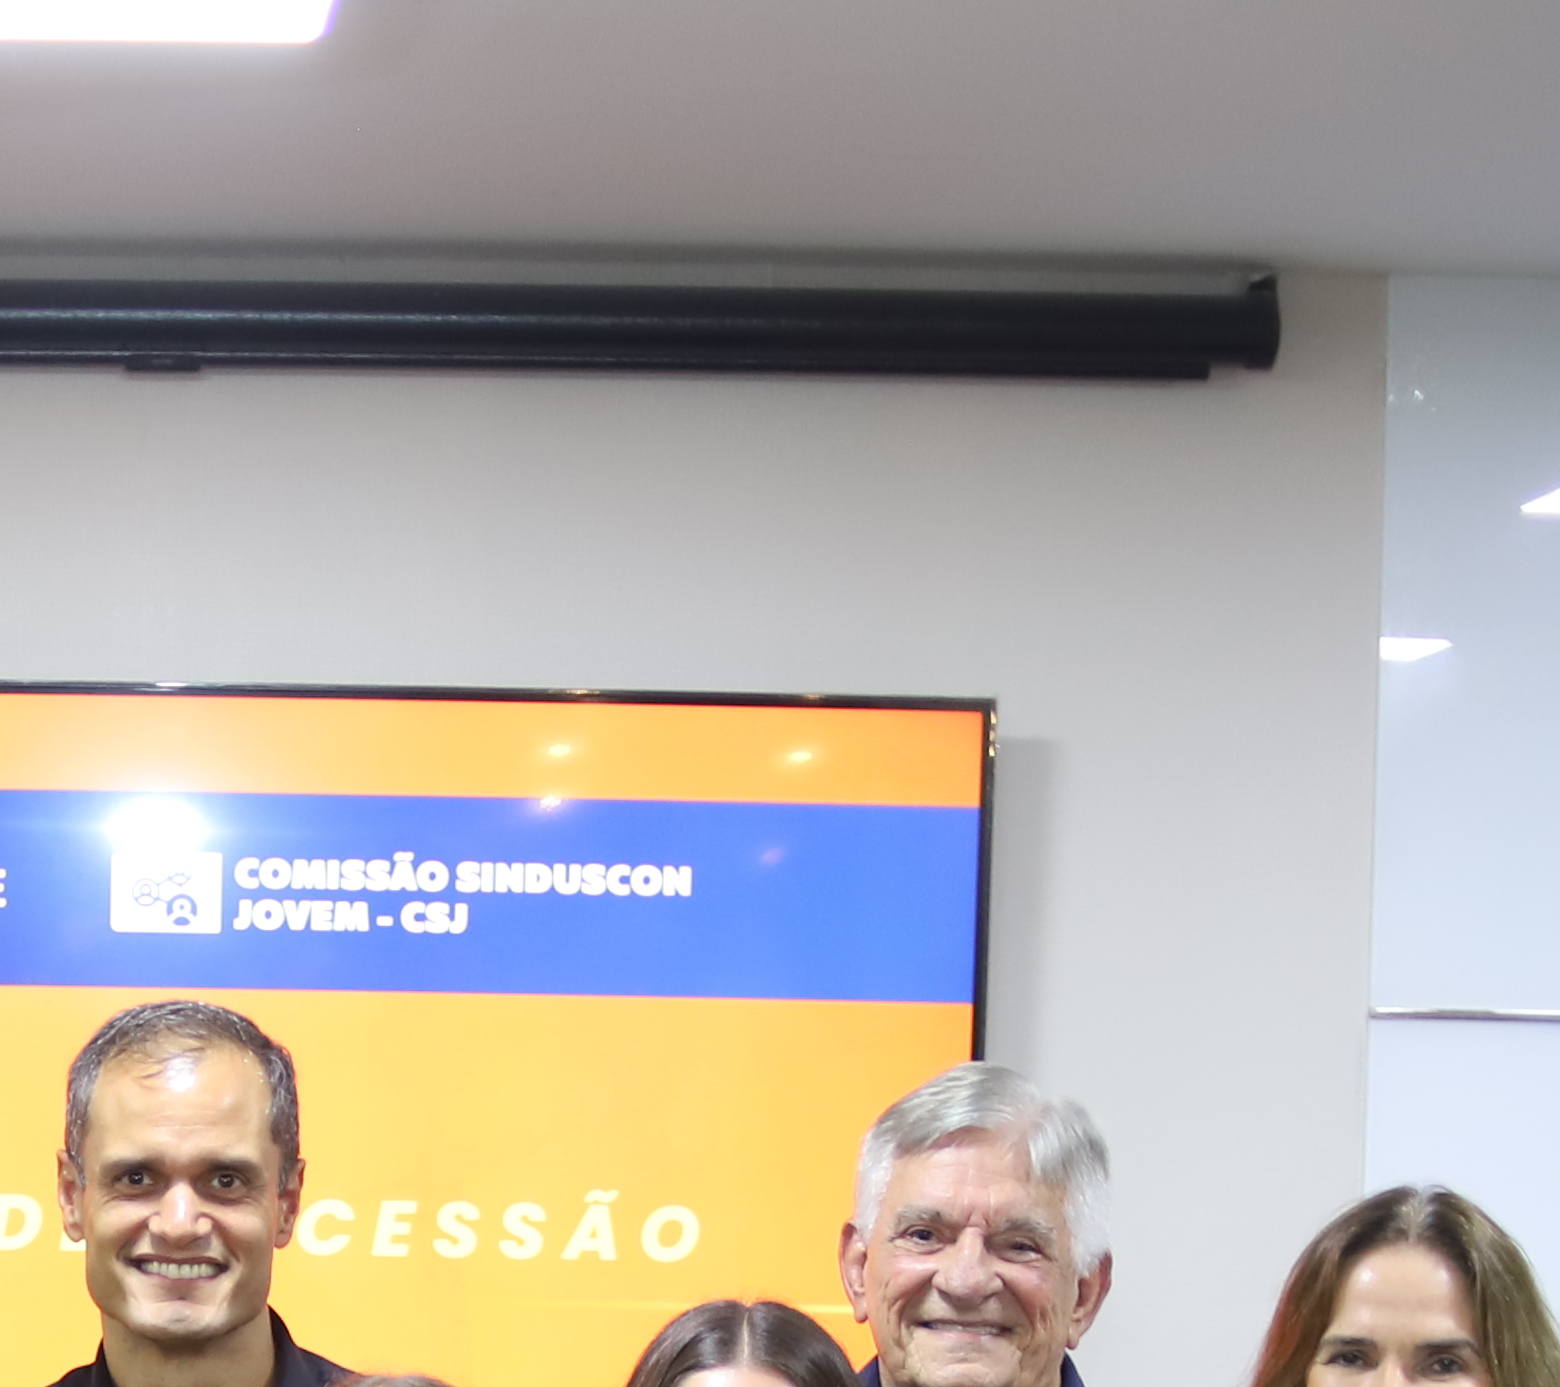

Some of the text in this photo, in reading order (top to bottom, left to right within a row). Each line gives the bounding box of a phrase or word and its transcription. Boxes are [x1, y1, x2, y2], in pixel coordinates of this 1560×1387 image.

[233, 850, 693, 897] COMISSÃO SINDUSCON
[232, 898, 371, 932] JOVEM
[399, 900, 469, 934] CSJ
[295, 1188, 700, 1264] CESSÃO
